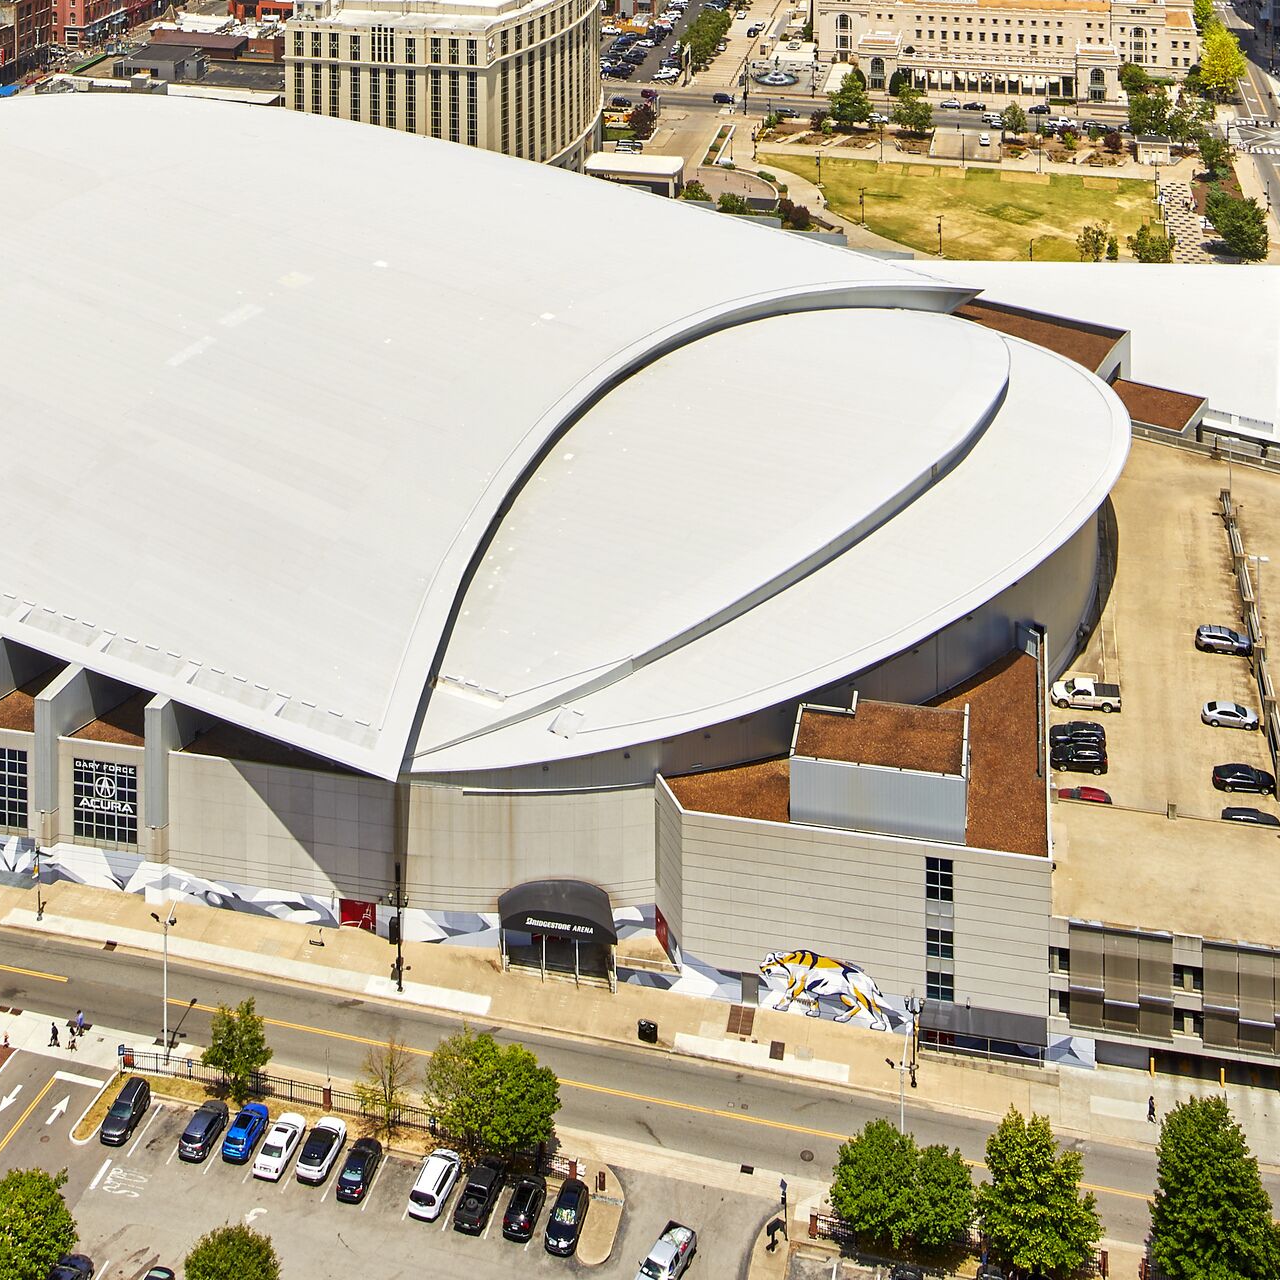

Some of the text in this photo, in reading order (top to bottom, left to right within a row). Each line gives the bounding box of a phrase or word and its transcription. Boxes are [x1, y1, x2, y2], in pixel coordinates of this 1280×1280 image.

[75, 761, 135, 774] GARY FORCE
[79, 798, 133, 813] ACURA
[525, 917, 594, 934] BRIDGESTONE ARENA
